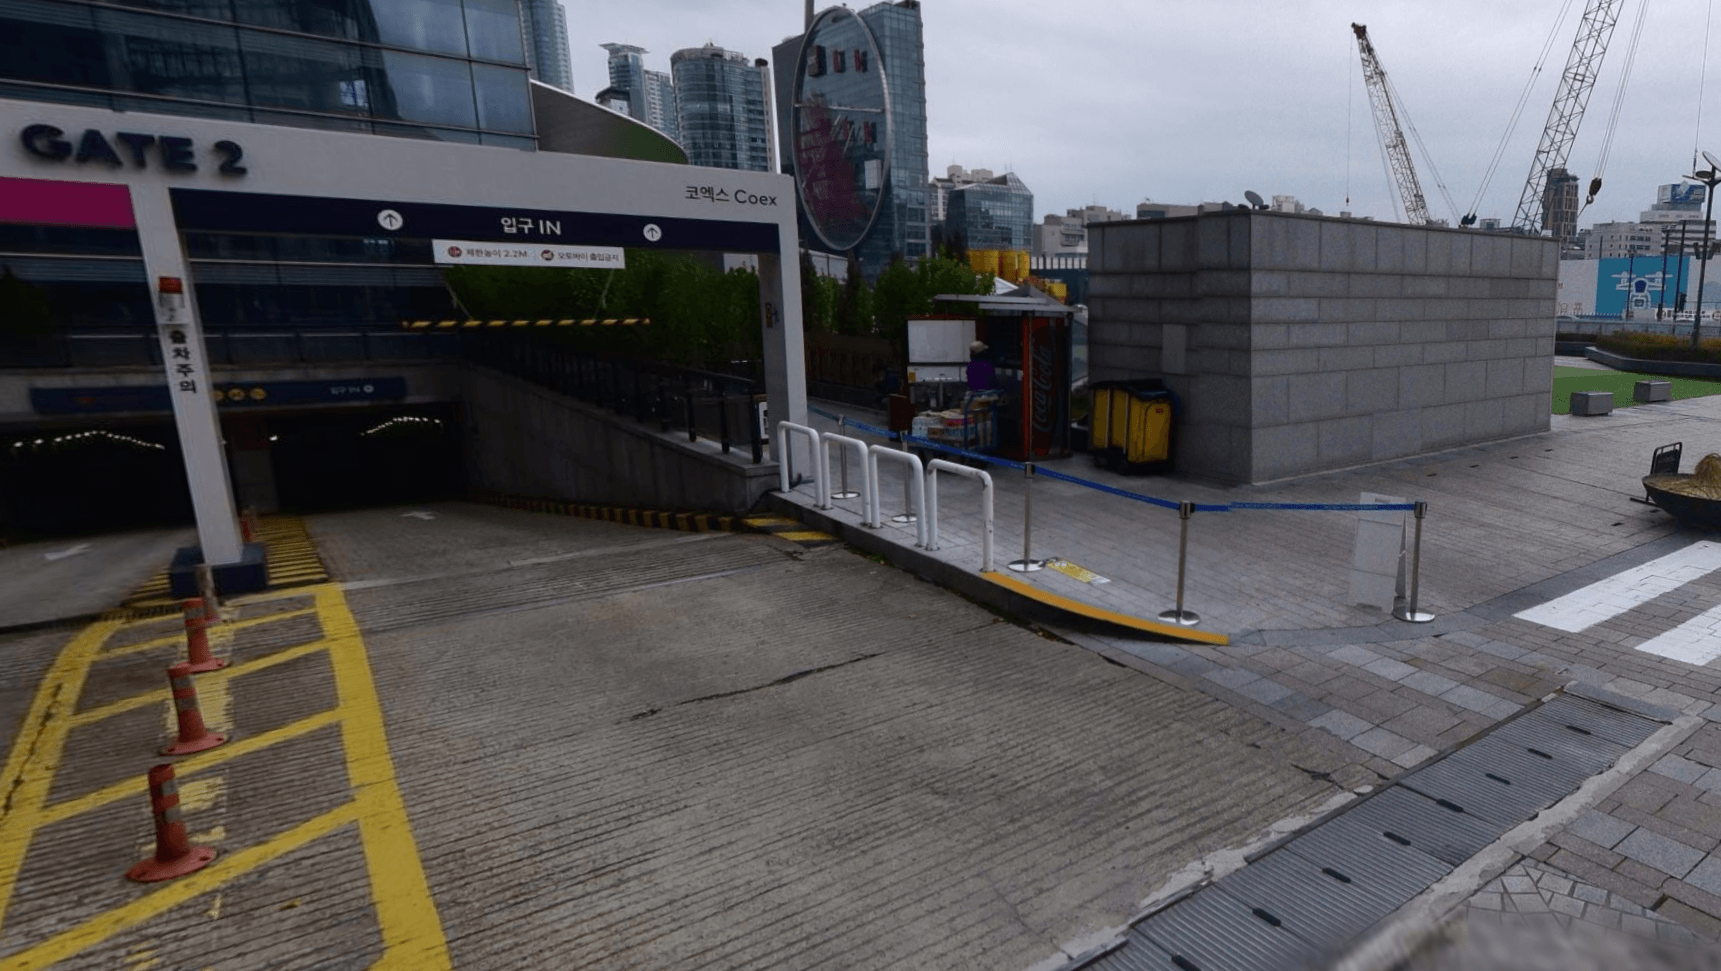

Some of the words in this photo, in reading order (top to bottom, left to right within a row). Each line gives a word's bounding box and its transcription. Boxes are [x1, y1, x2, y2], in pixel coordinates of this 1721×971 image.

[22, 124, 197, 172] GATE
[215, 141, 248, 175] 2
[685, 185, 730, 203] 코엑스
[733, 190, 778, 207] Coex
[501, 217, 535, 235] 입구
[539, 219, 561, 236] IN
[503, 249, 528, 259] 2.2M
[169, 330, 197, 394] 출차주의
